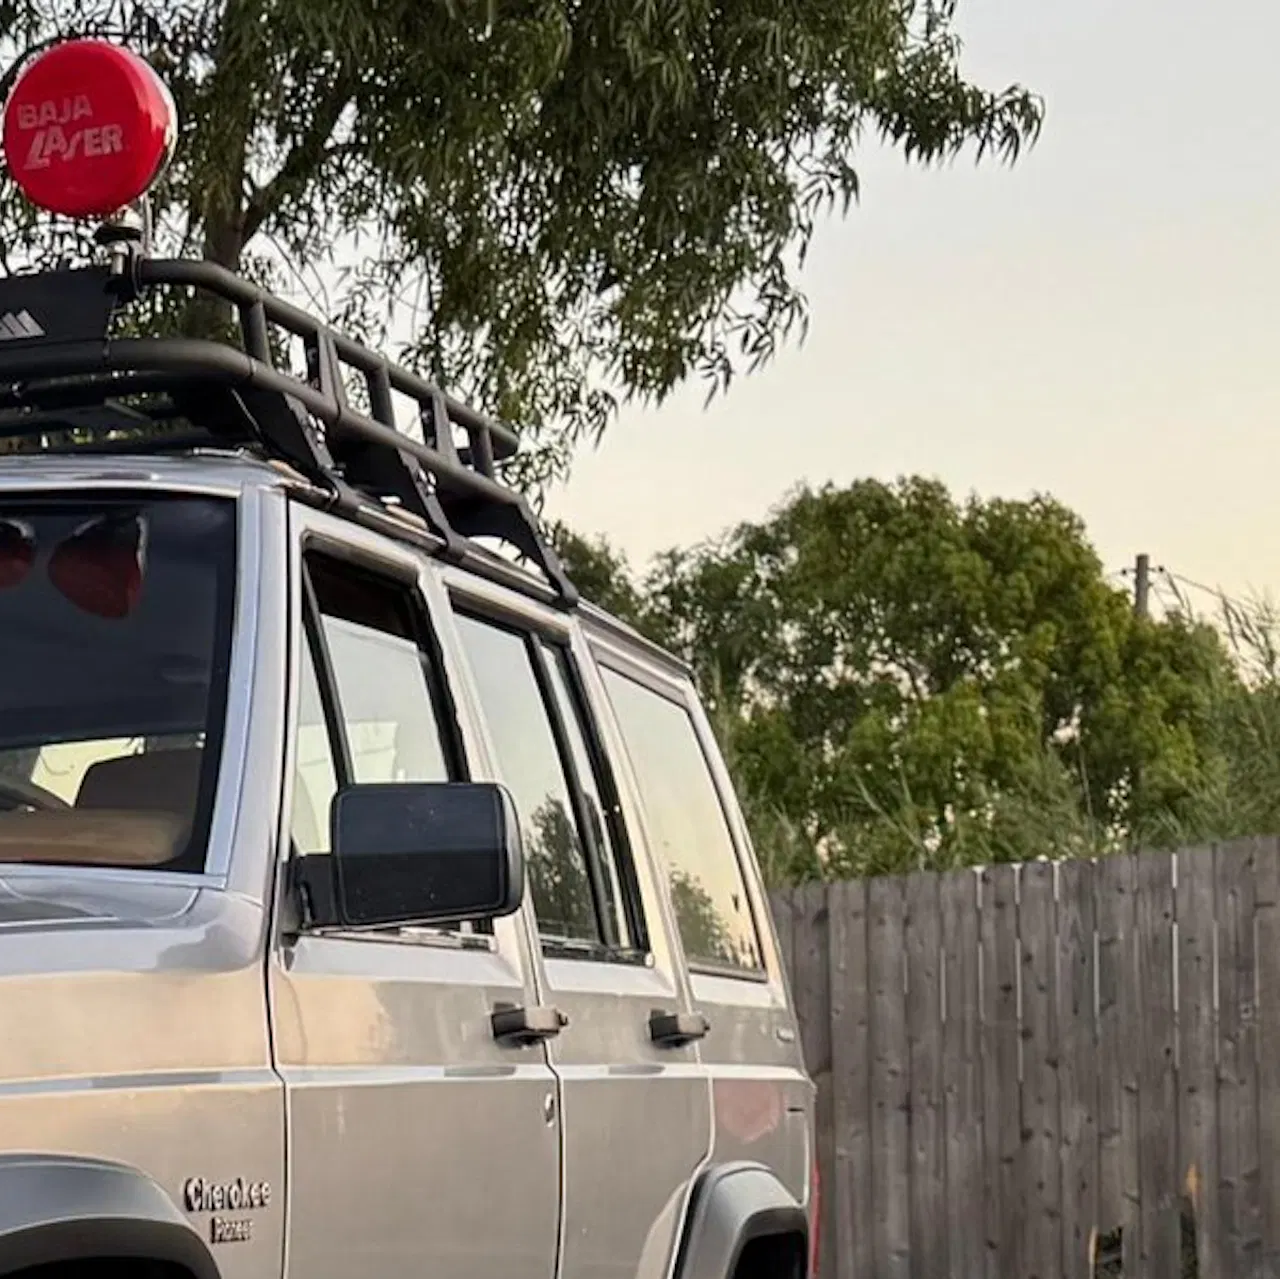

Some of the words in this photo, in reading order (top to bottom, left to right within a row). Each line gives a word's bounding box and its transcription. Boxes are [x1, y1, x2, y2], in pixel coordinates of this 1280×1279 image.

[16, 94, 94, 131] BAJA
[22, 123, 124, 170] LASER
[182, 1177, 272, 1213] Cherokee
